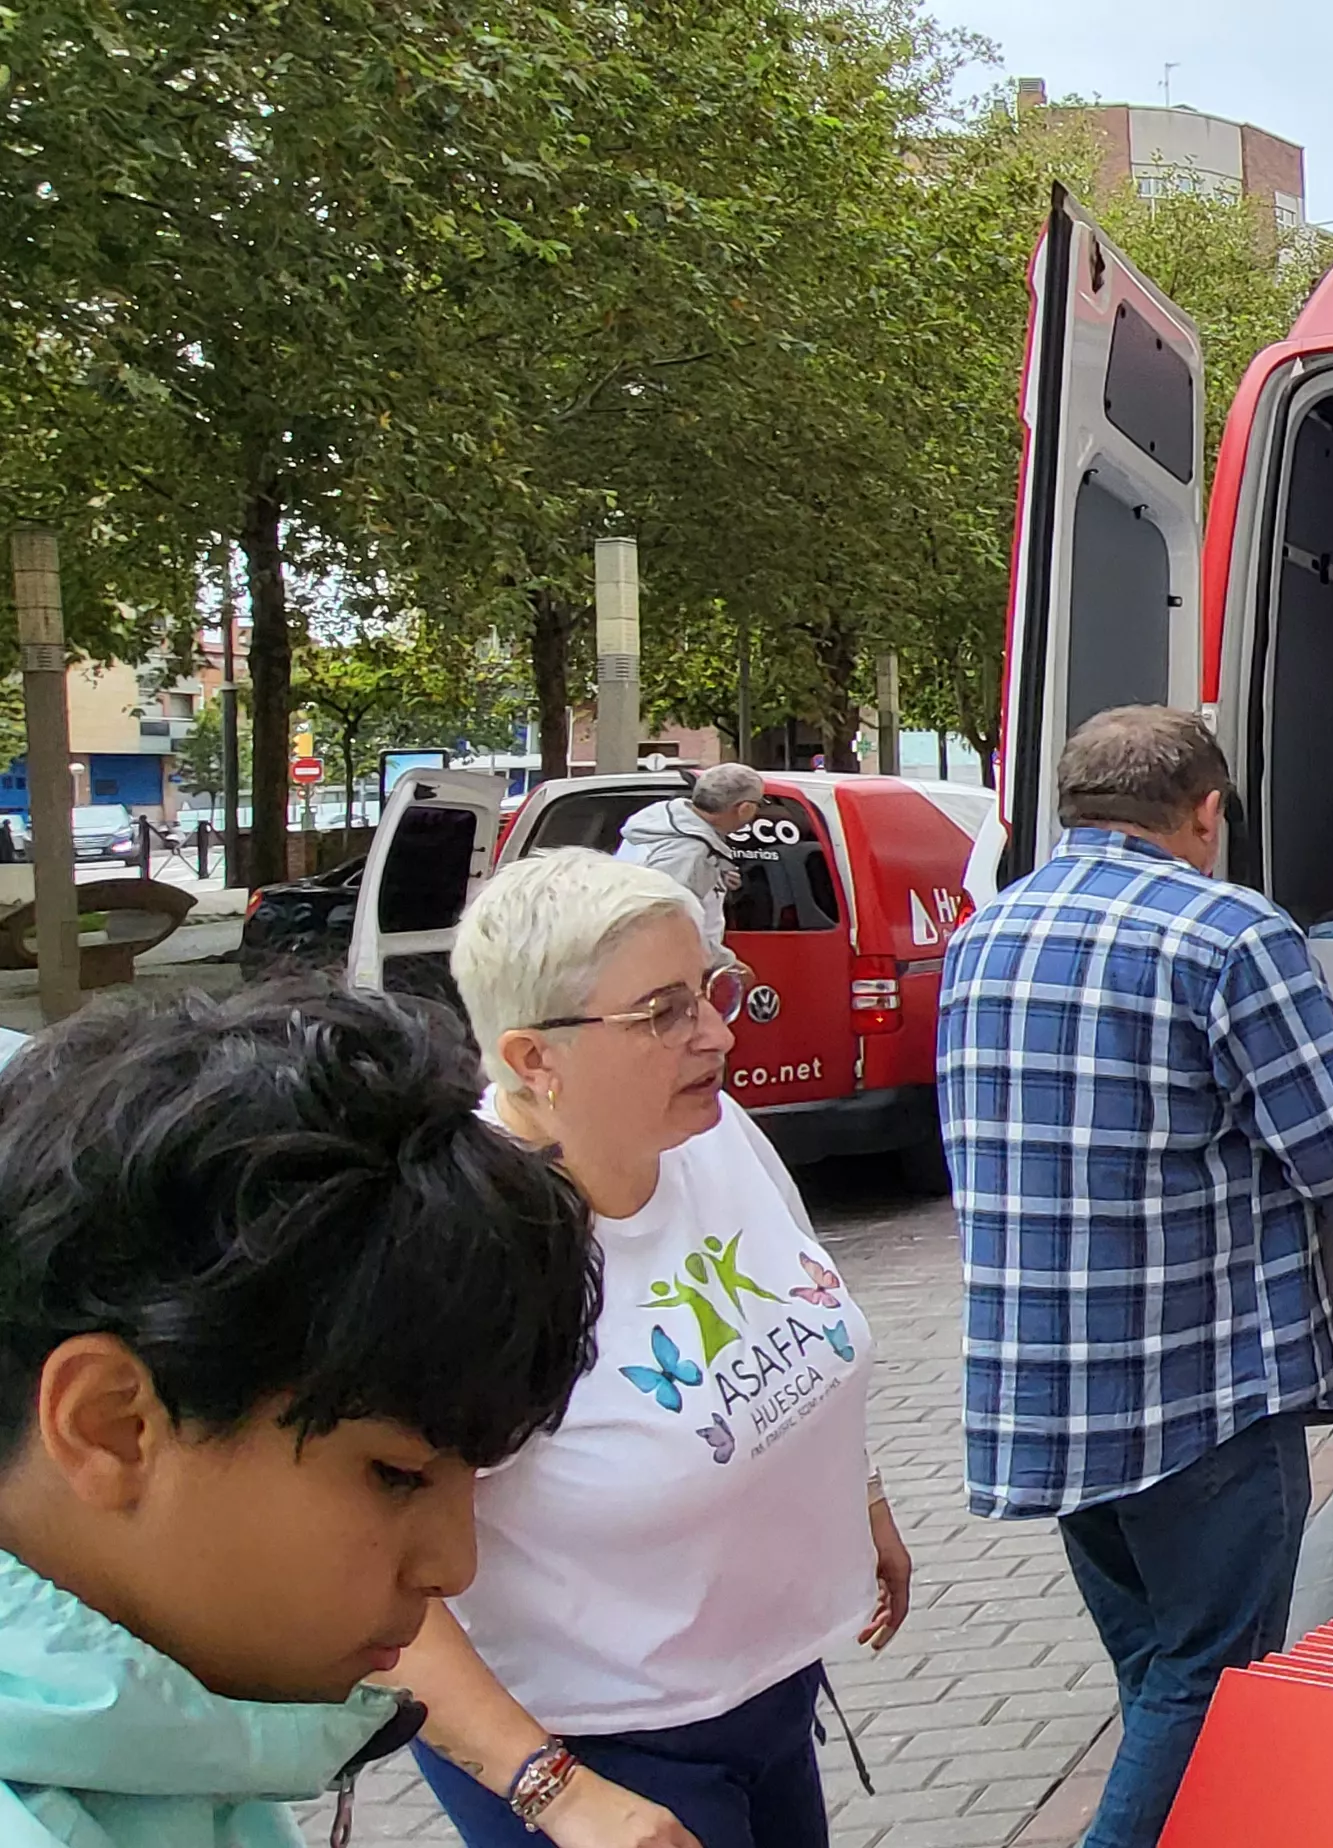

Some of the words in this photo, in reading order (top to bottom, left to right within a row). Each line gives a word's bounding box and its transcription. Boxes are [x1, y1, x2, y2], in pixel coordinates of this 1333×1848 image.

[733, 1056, 823, 1088] co.net
[714, 1316, 825, 1417] ASAFA
[750, 1365, 824, 1436] HUESCA
